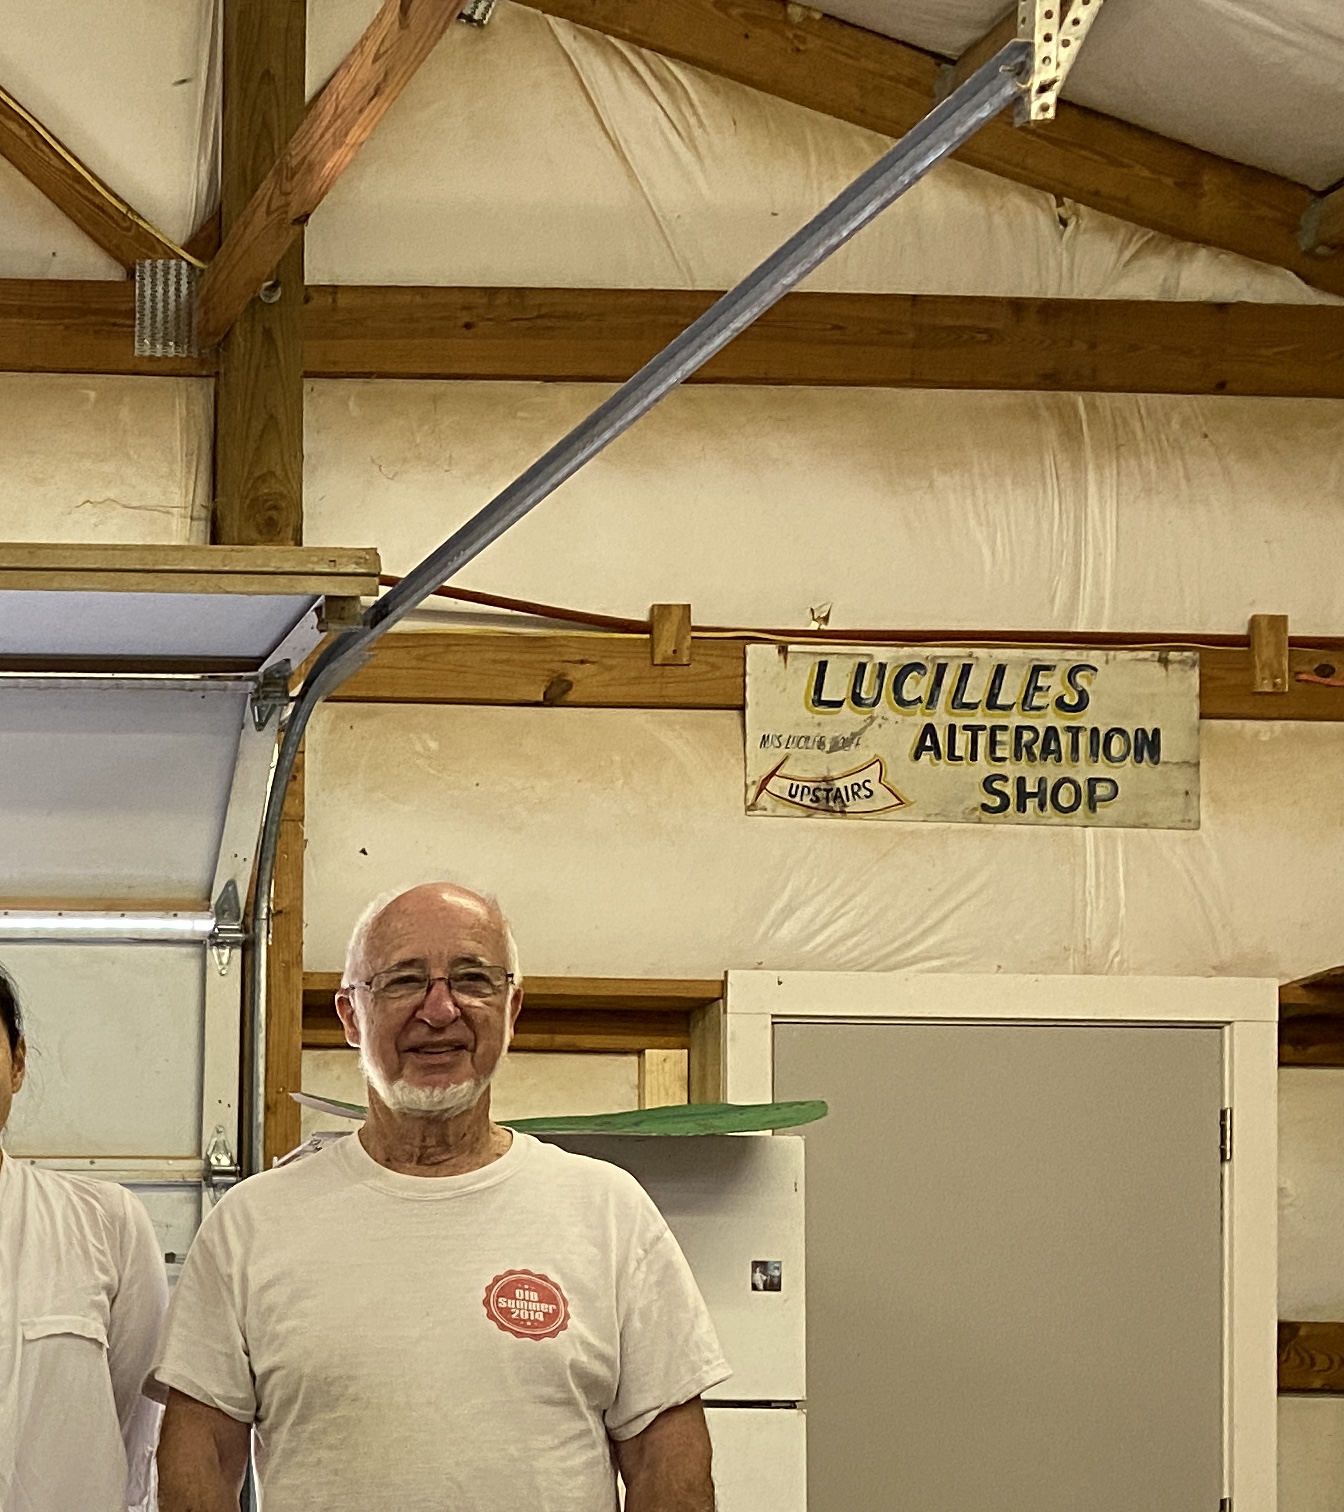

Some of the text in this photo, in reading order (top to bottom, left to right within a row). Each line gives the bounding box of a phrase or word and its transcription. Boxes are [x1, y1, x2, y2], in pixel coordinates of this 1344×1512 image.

[806, 658, 1099, 714] LUCILLES
[913, 721, 1162, 766] ALTERATION
[787, 778, 874, 805] UPSTAIRS
[980, 773, 1119, 815] SHOP
[498, 1297, 556, 1313] Summer
[511, 1309, 544, 1321] 2014
